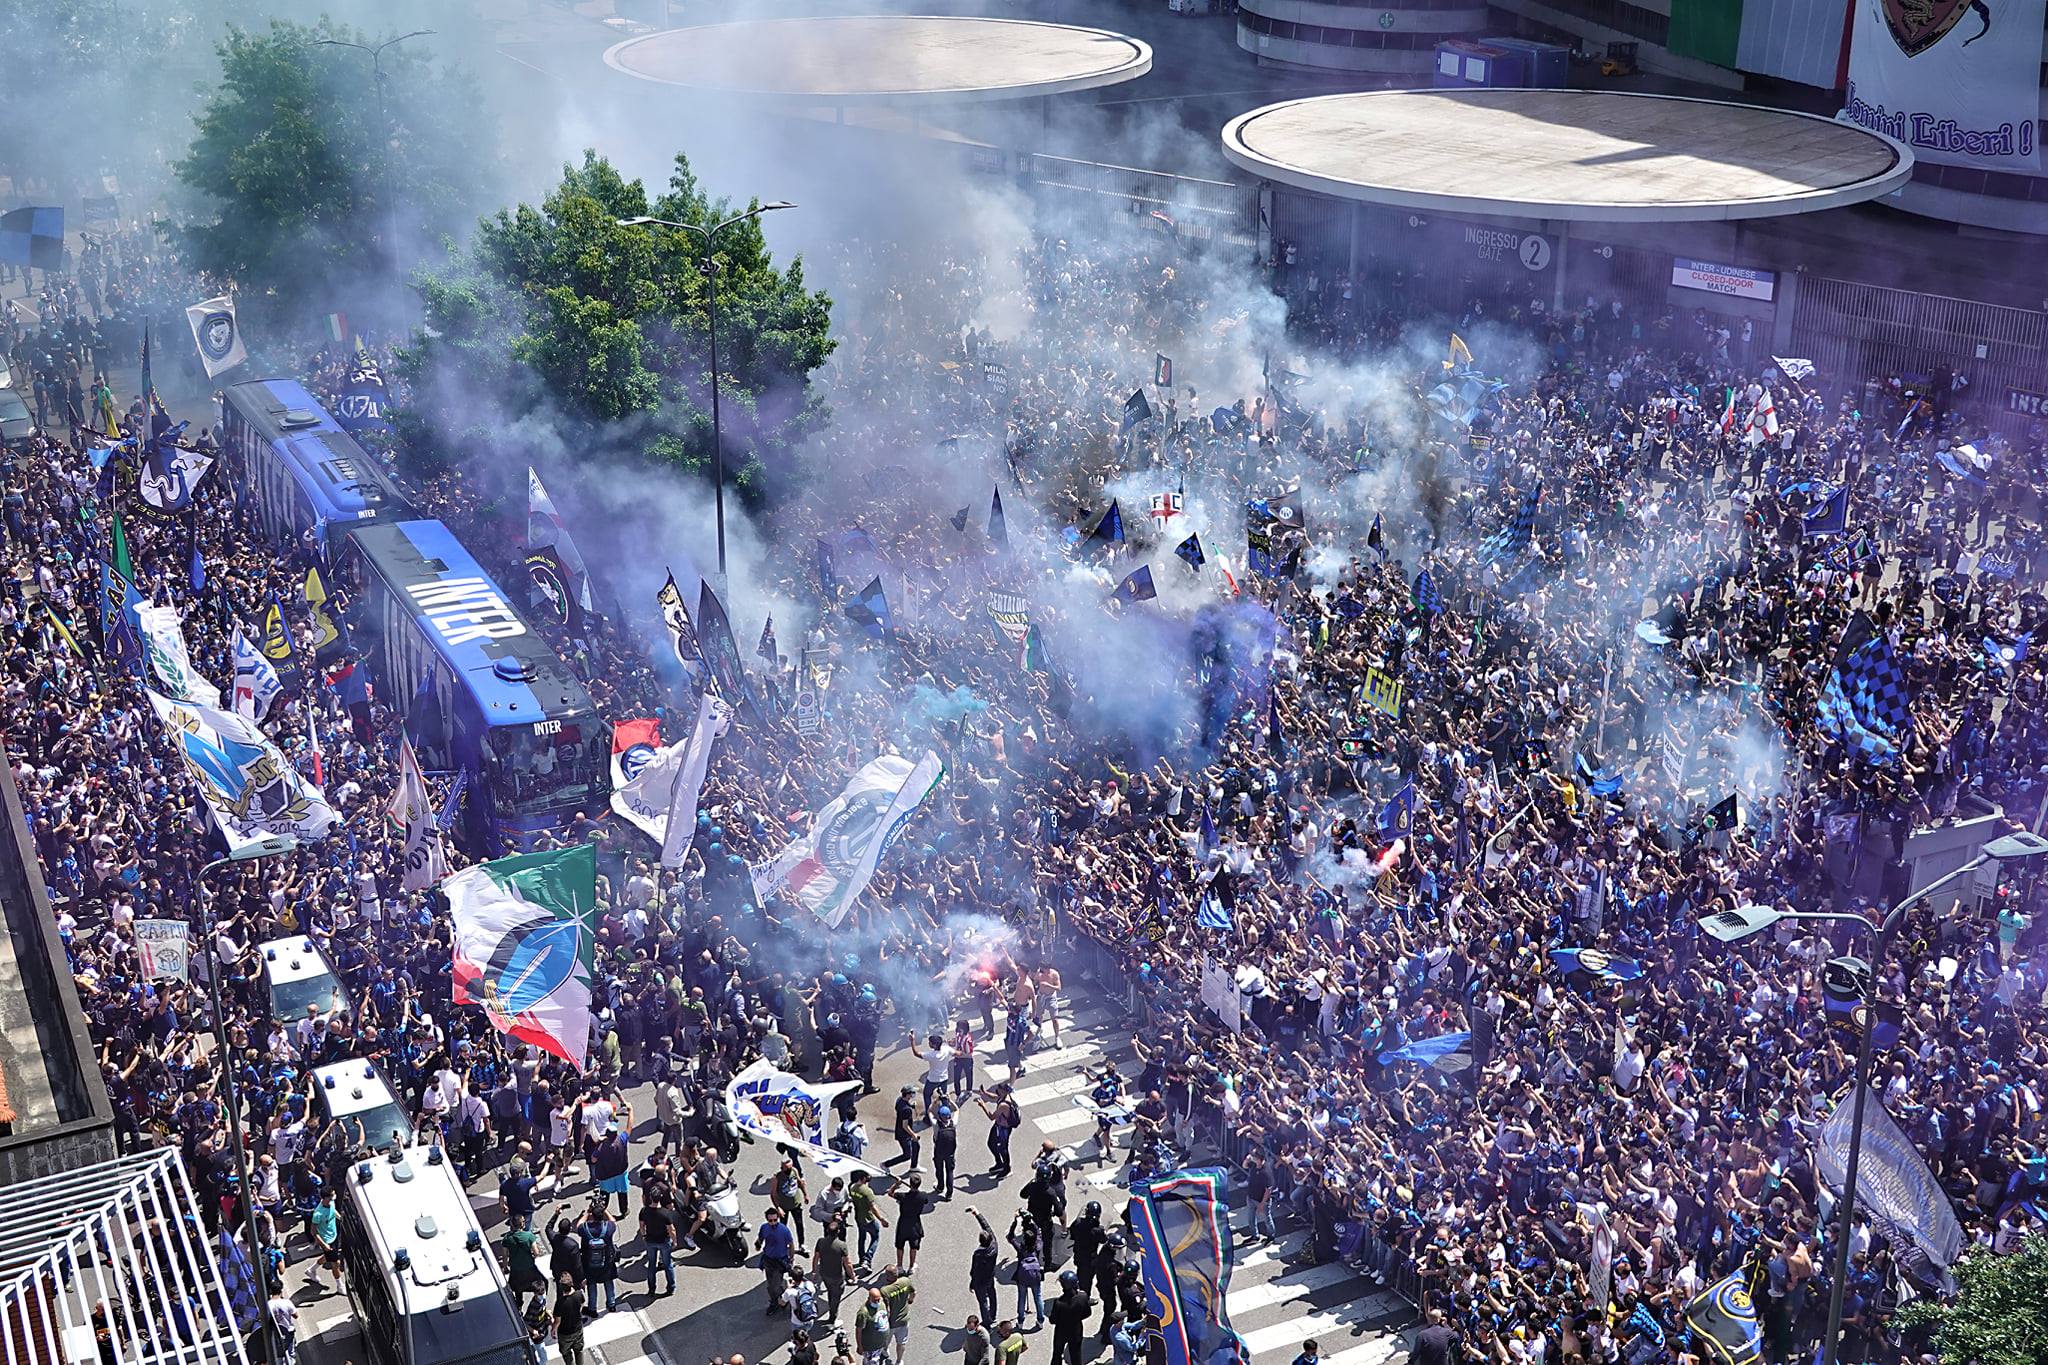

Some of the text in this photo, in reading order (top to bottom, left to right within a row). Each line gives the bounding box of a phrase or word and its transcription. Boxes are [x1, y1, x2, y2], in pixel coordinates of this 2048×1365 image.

[1910, 112, 2014, 156] Liberi
[1465, 227, 1542, 267] INGRESSO 2
[1477, 245, 1503, 263] GATE
[1691, 261, 1716, 273] INTER
[1721, 266, 1756, 280] UDINESE
[1691, 271, 1754, 289] CLOSED-DOOR
[1706, 282, 1737, 295] MATCH
[357, 509, 377, 519] INTER
[405, 577, 527, 646] INTER
[533, 720, 562, 736] INTER
[246, 756, 278, 788] 50
[270, 820, 301, 835] 2019
